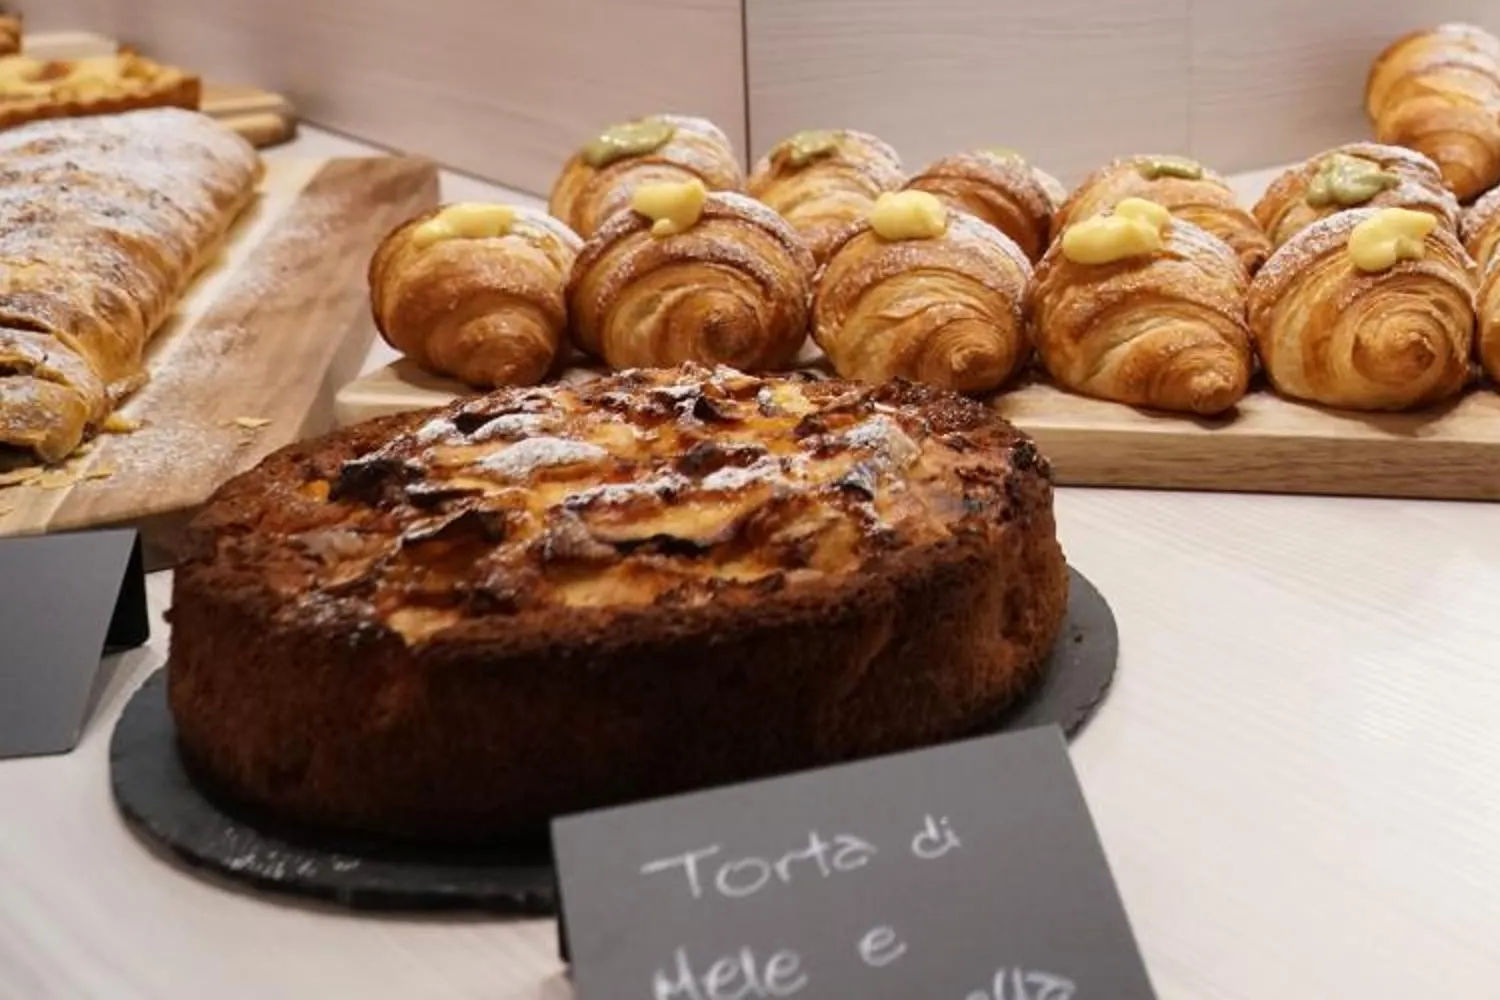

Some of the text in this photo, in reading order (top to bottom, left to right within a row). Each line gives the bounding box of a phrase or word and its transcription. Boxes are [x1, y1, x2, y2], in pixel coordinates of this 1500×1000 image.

[640, 815, 963, 898] Torta di
[653, 924, 907, 1000] Mele e
